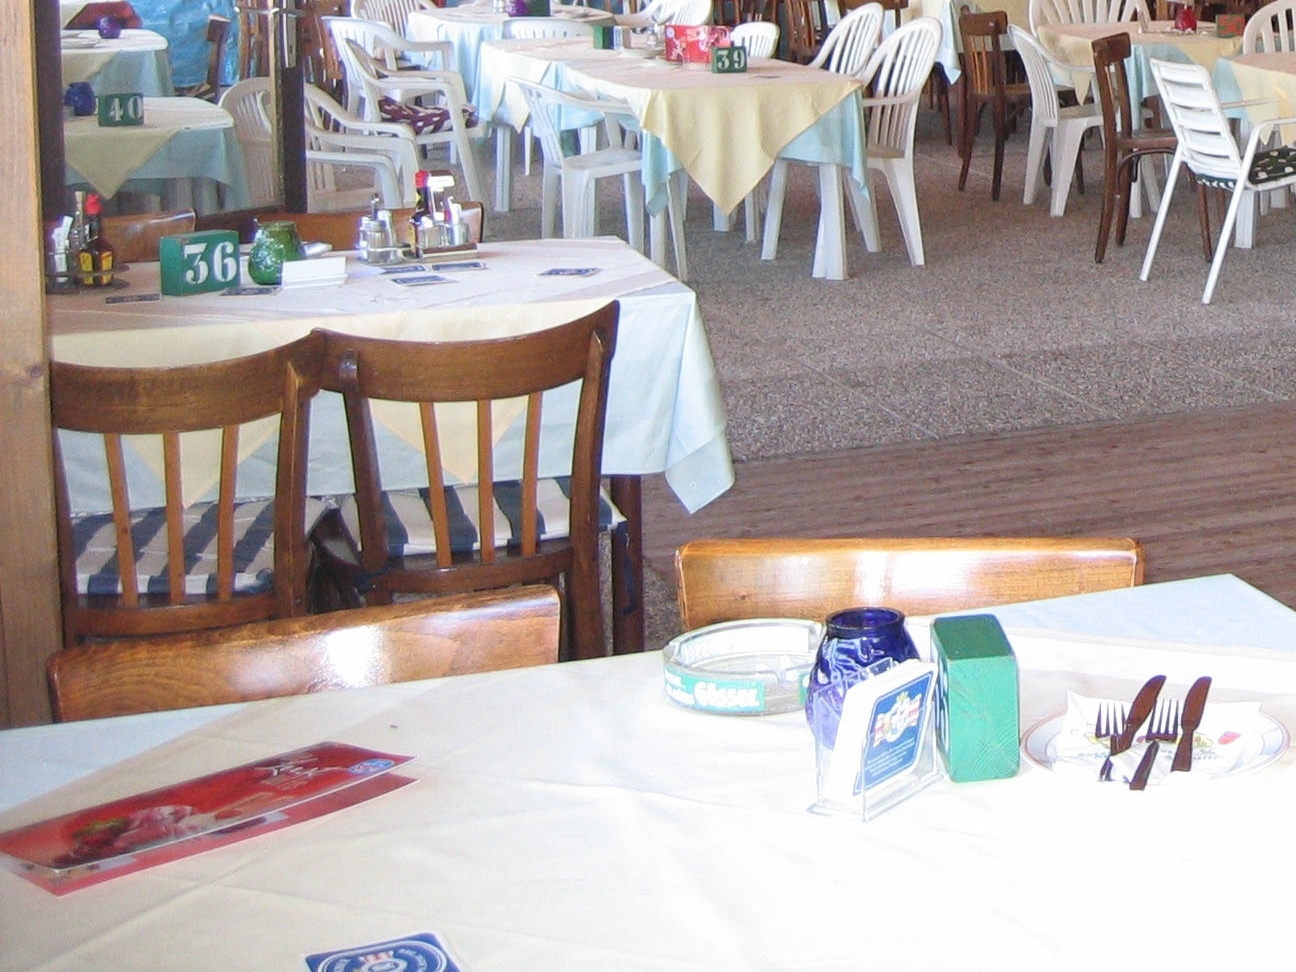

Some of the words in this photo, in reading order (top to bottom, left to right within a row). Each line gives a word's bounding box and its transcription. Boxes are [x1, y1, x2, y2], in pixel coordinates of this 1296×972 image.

[717, 49, 745, 70] 39
[109, 96, 144, 122] 40
[183, 241, 238, 285] 36
